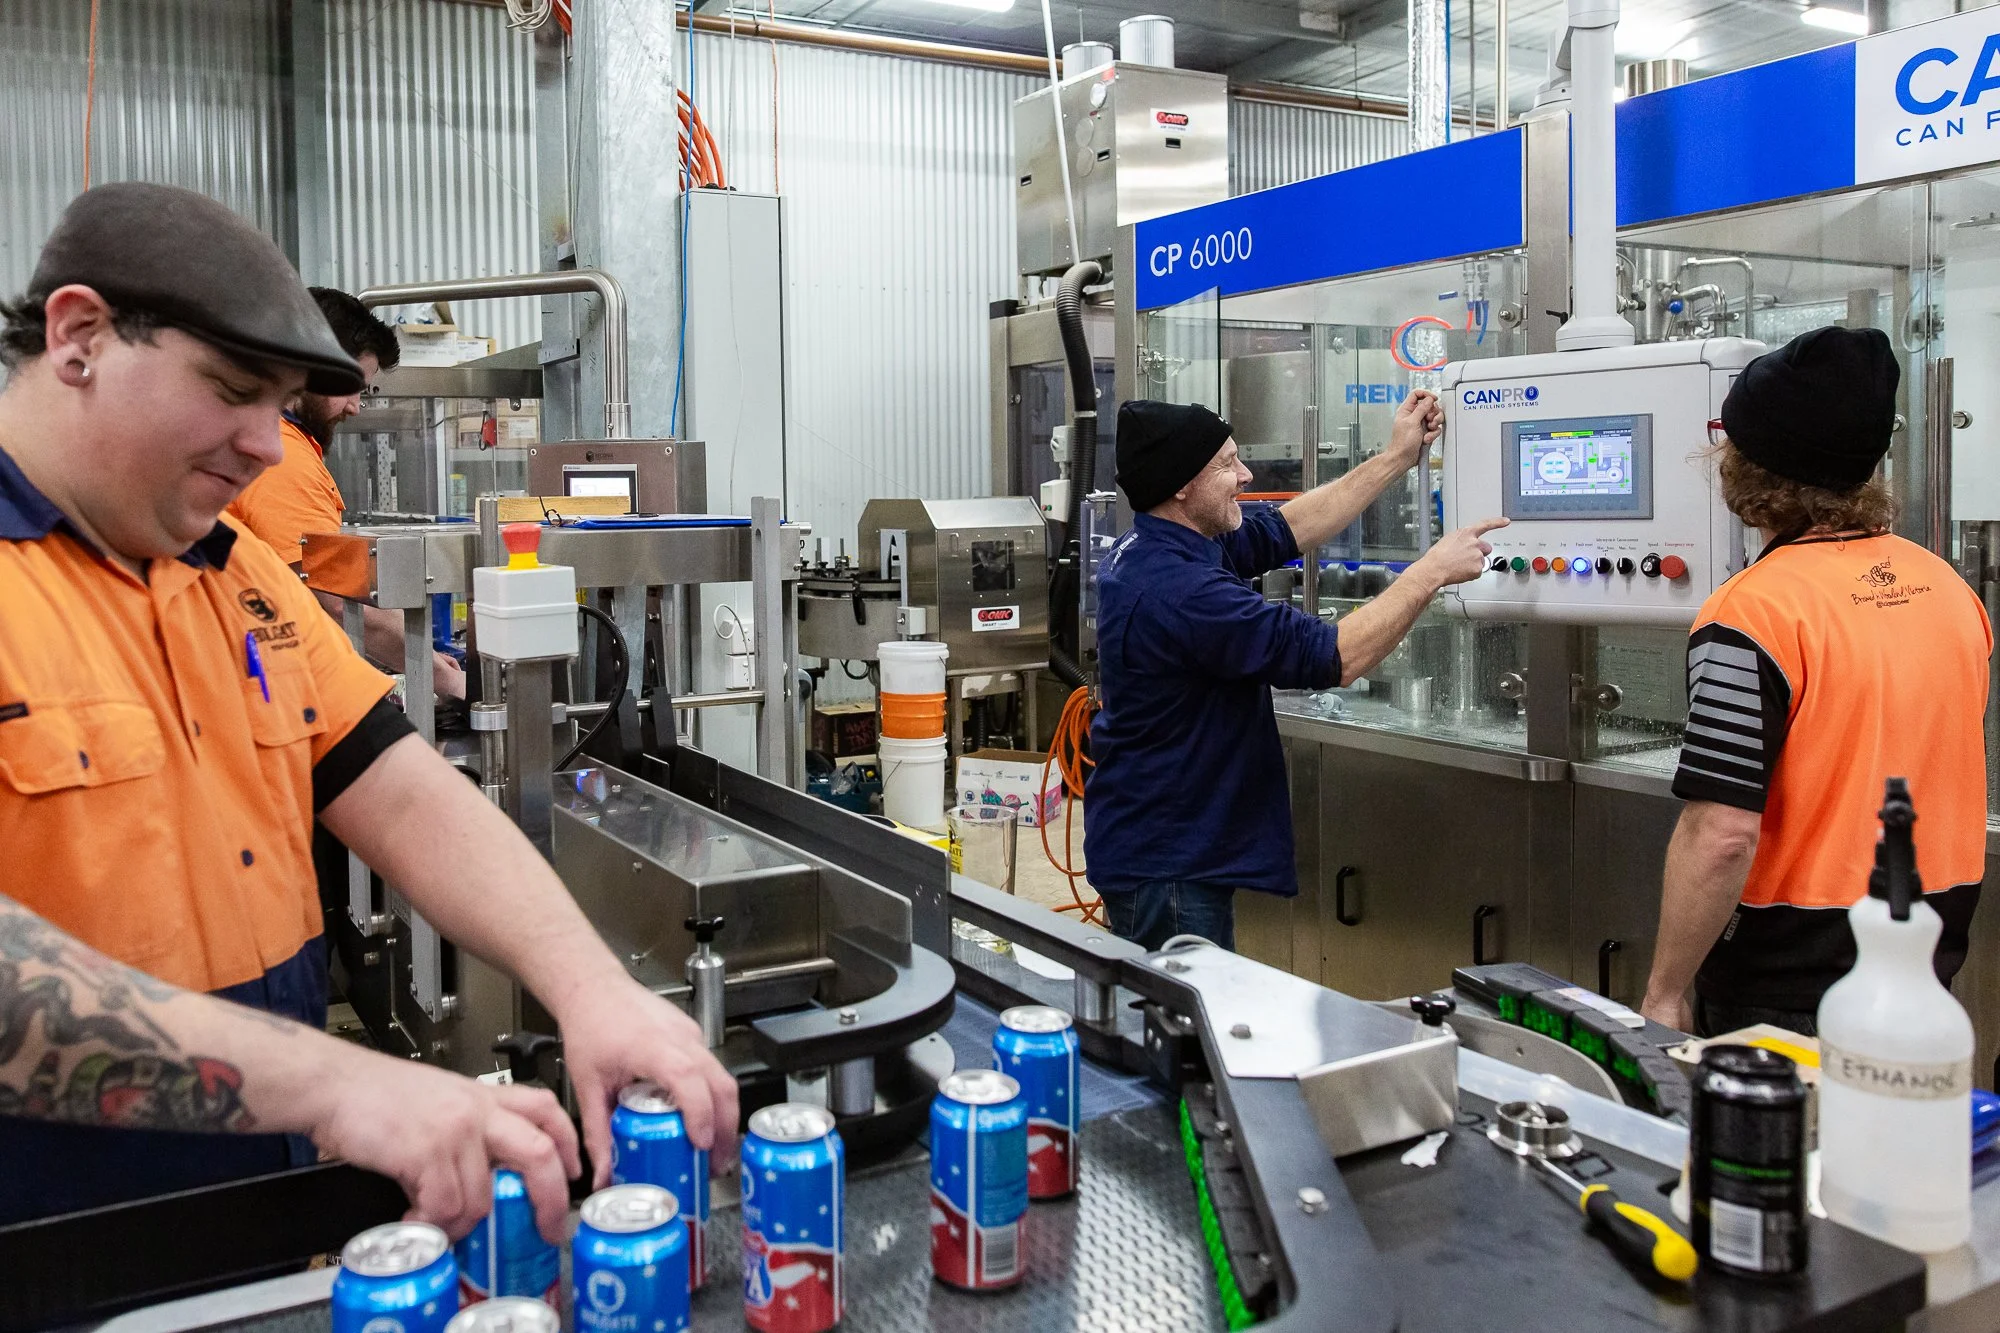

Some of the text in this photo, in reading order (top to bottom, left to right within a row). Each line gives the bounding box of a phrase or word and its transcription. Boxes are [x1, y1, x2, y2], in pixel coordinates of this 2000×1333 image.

[1896, 117, 1964, 146] CAN
[1150, 227, 1252, 277] CP 6000
[1345, 384, 1409, 403] REN
[1463, 386, 1540, 405] CANPRO
